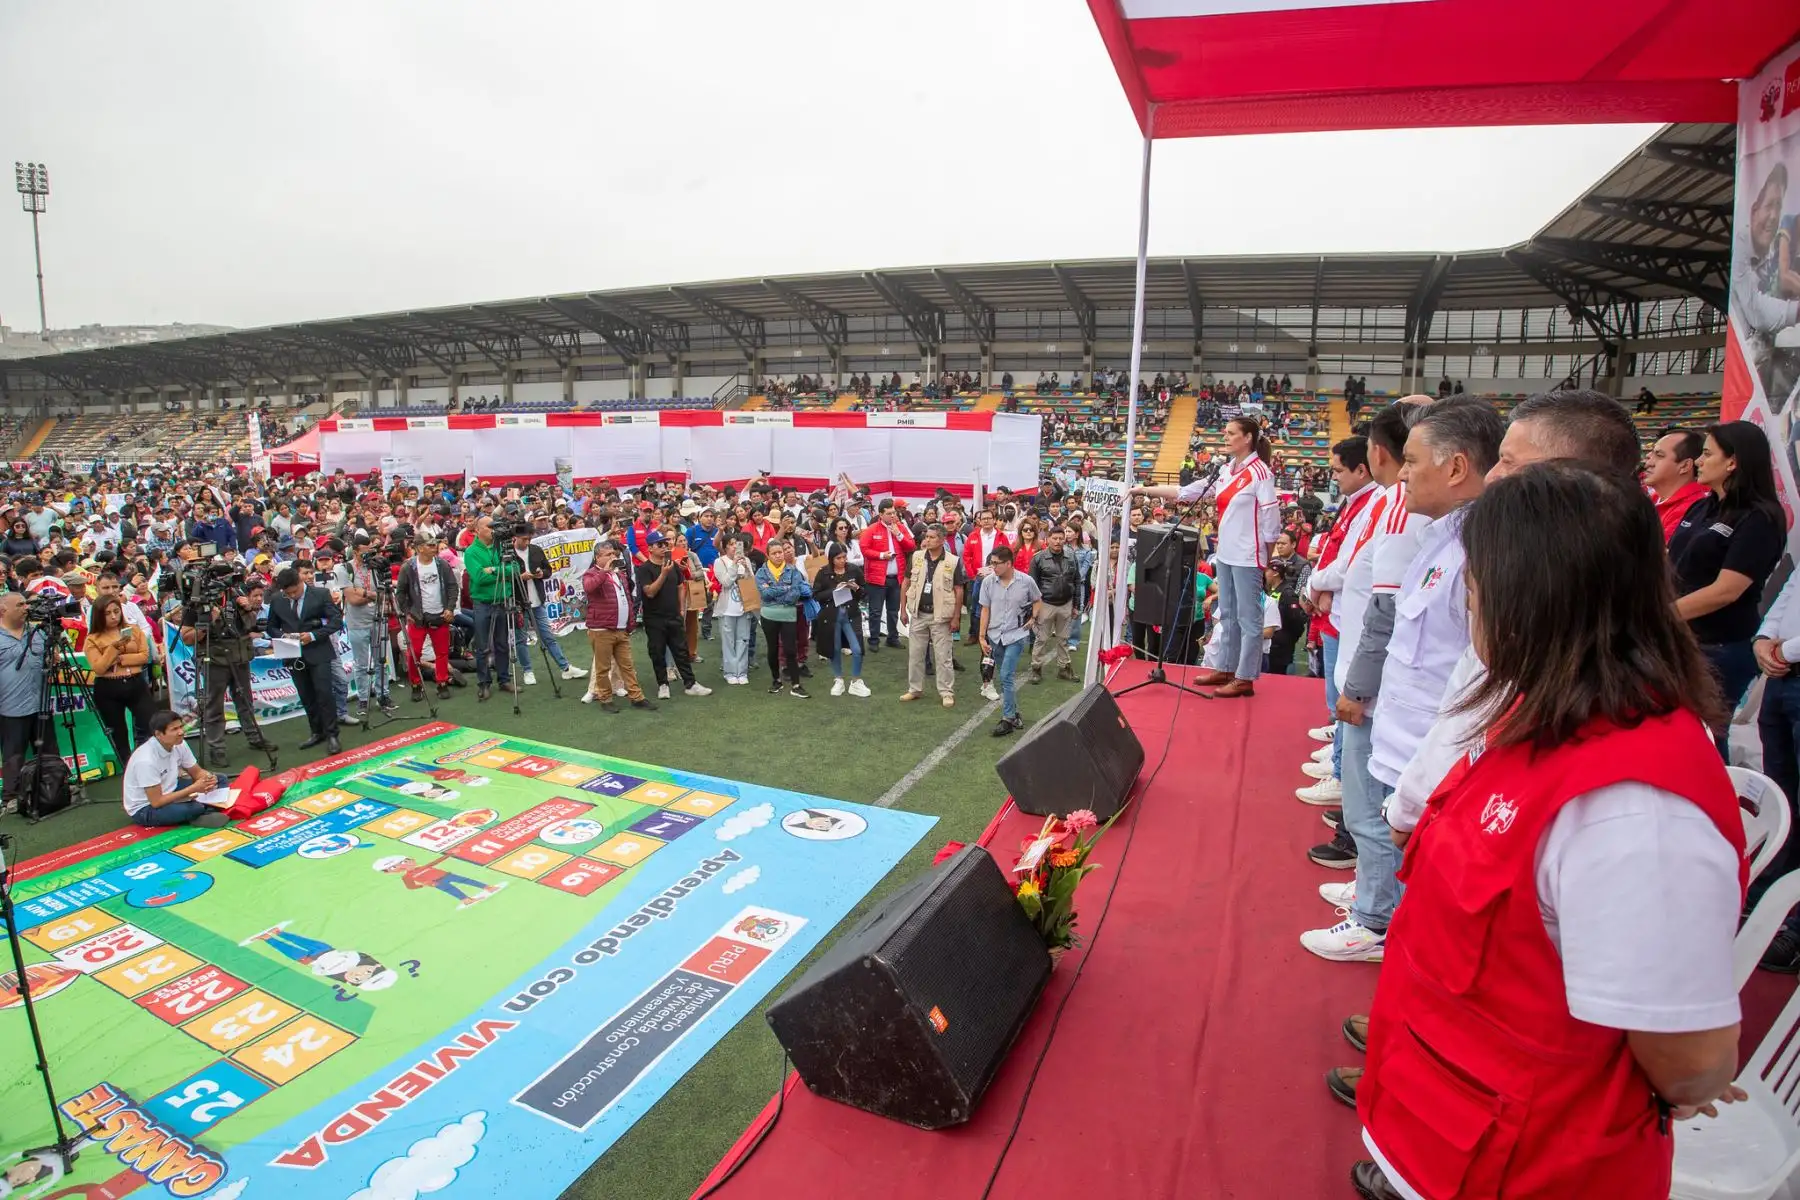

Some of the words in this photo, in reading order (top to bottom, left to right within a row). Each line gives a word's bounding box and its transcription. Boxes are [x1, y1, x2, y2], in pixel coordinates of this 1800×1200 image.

[338, 802, 375, 818] 14
[420, 825, 457, 841] 12
[645, 822, 673, 835] 7
[470, 839, 504, 855] 11
[123, 862, 165, 880] 18
[572, 848, 743, 965] Aprendiendo
[48, 919, 96, 941] 19
[64, 928, 130, 956] REGALO
[82, 934, 144, 963] 20
[707, 944, 746, 974] PERÚ
[122, 955, 177, 984] 21
[675, 977, 690, 985] y
[164, 979, 235, 1015] 22
[502, 967, 577, 1013] con
[684, 982, 703, 994] de
[210, 1001, 279, 1040] 23
[605, 983, 683, 1043] Saneamiento
[634, 994, 692, 1035] Vivienda,
[662, 986, 721, 1032] Ministerio
[262, 1026, 332, 1068] 24
[552, 1036, 640, 1108] Construcción
[164, 1079, 245, 1123] 25
[268, 1019, 520, 1169] VIVIENDA
[58, 1082, 228, 1198] GANASTE
